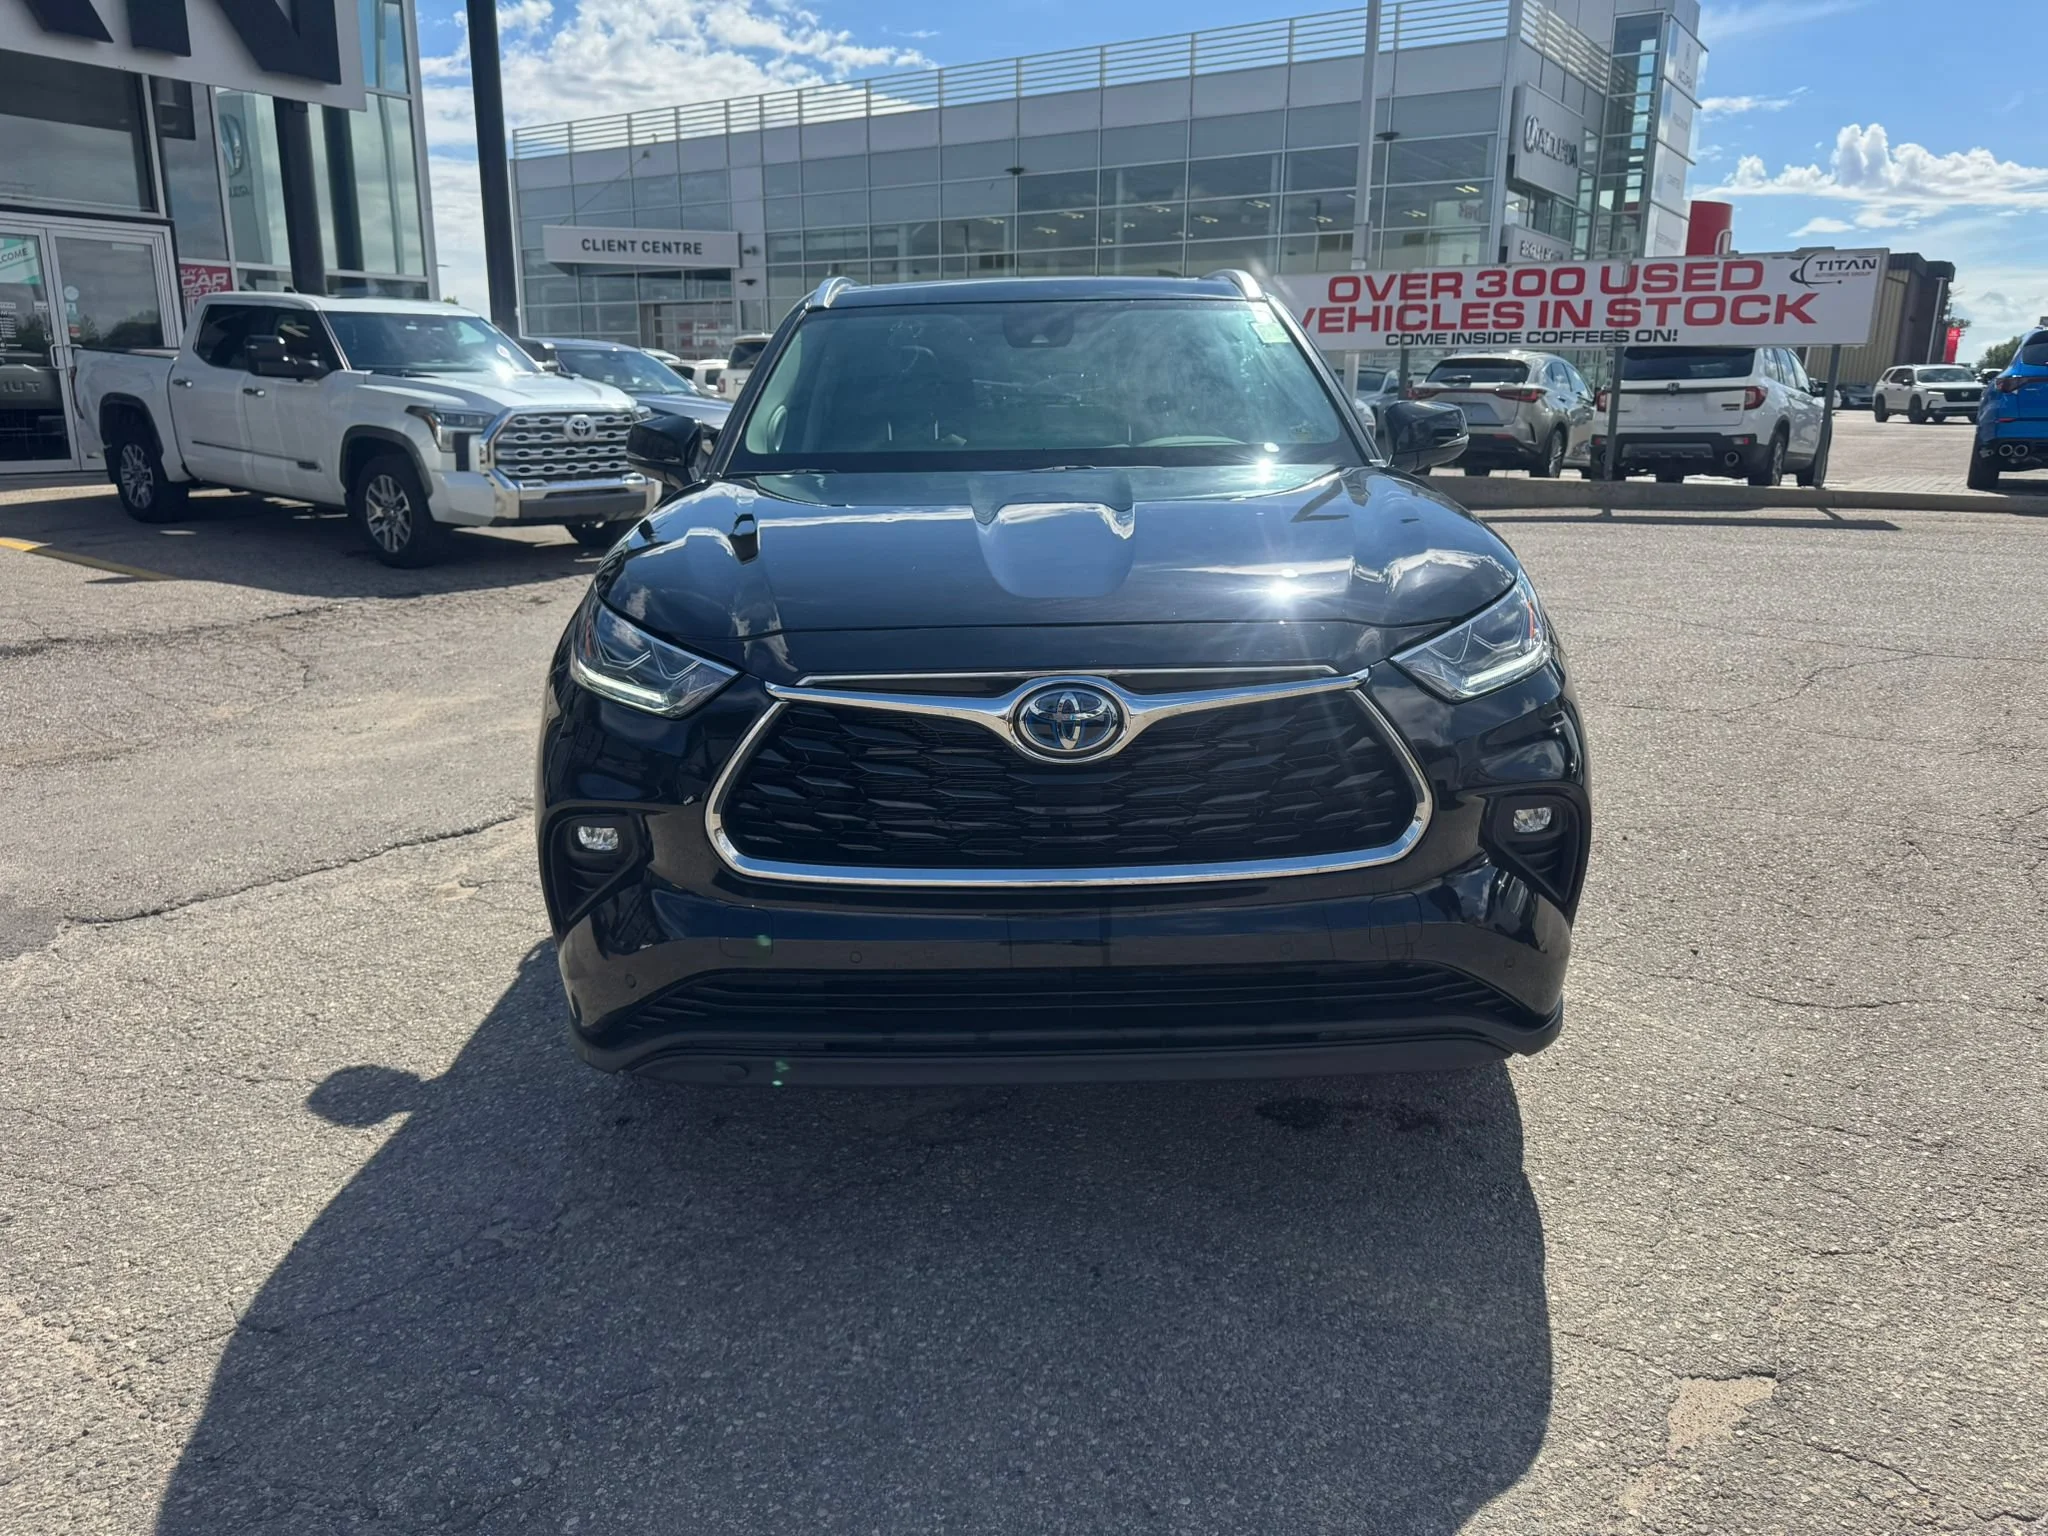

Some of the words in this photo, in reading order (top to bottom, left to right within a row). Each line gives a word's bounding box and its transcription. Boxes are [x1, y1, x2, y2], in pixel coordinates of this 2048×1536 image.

[581, 238, 637, 253] CLIENT
[642, 241, 703, 255] CENTRE
[1815, 259, 1877, 272] TITAN
[182, 273, 228, 289] CAR
[1328, 272, 1463, 303] OVER
[1475, 267, 1586, 298] 300
[1600, 260, 1763, 295] USED
[183, 288, 201, 297] GO
[1538, 299, 1592, 329] IN
[1605, 293, 1819, 328] STOCK
[1386, 332, 1447, 346] COME
[1451, 331, 1522, 345] INSIDE
[1526, 330, 1630, 344] COFFEES
[1634, 329, 1678, 342] ON!
